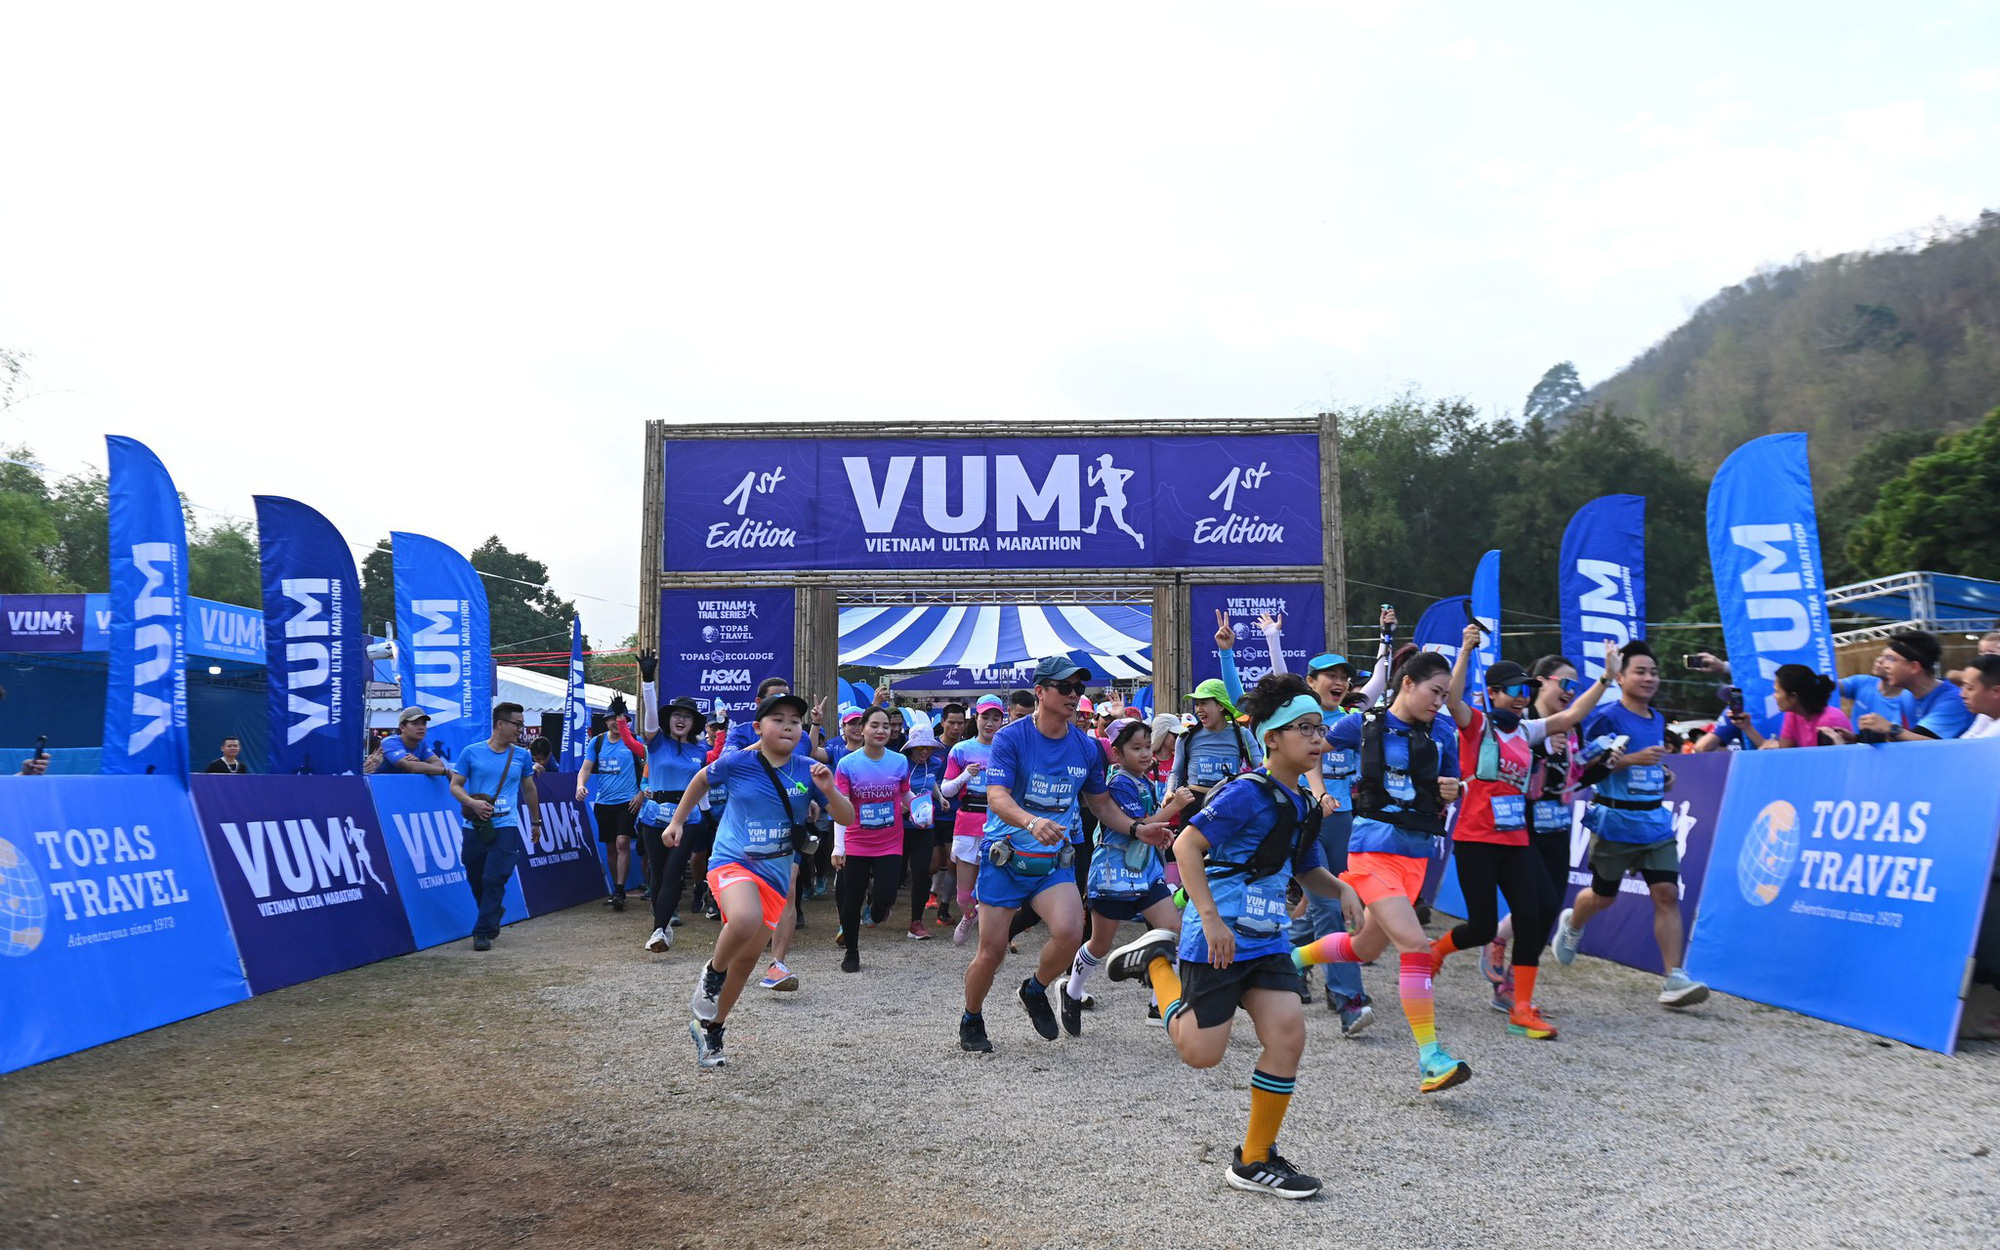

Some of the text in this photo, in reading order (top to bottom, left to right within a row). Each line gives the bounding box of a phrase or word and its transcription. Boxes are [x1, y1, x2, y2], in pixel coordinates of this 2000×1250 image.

[723, 466, 786, 515] 1st
[842, 454, 1080, 533] VUM
[1208, 461, 1271, 511] 1st
[706, 518, 796, 549] Edition
[865, 536, 1081, 552] VIETNAM ULTRA MARATHON
[1193, 513, 1284, 544] Edition
[698, 601, 747, 611] VIETNAM
[698, 610, 747, 619] TRAIL SERIES
[1227, 598, 1277, 608] VIETNAM
[1227, 607, 1249, 616] TRAIL
[7, 611, 61, 631] VUM
[199, 606, 257, 649] VUM
[719, 632, 754, 640] TRAVEL
[127, 542, 173, 756] VUM
[281, 578, 329, 746] VUM
[331, 578, 342, 725] VIETNAM ULTRA MARATHON
[411, 599, 461, 728] VUM
[460, 599, 473, 718] VIETNAM ULTRA MARATHON
[680, 652, 774, 661] TOPAS ECOLODGE
[1256, 650, 1306, 658] ECODGE
[700, 669, 752, 685] HOKA
[173, 668, 187, 728] VIETNAM
[1327, 752, 1345, 763] 1535
[1032, 780, 1072, 793] VUM M1271
[1812, 800, 1932, 844] TOPAS
[34, 825, 156, 870] TOPAS
[219, 817, 358, 898] VUM
[417, 875, 444, 890] VIETNAM
[1799, 850, 1938, 903] TRAVEL
[50, 869, 190, 921] TRAVEL
[257, 888, 363, 917] VIETNAM ULTRA MARATHON
[1246, 894, 1266, 906] VUM
[1246, 906, 1265, 916] 10 KM
[67, 916, 175, 948] Adventurous since 1973
